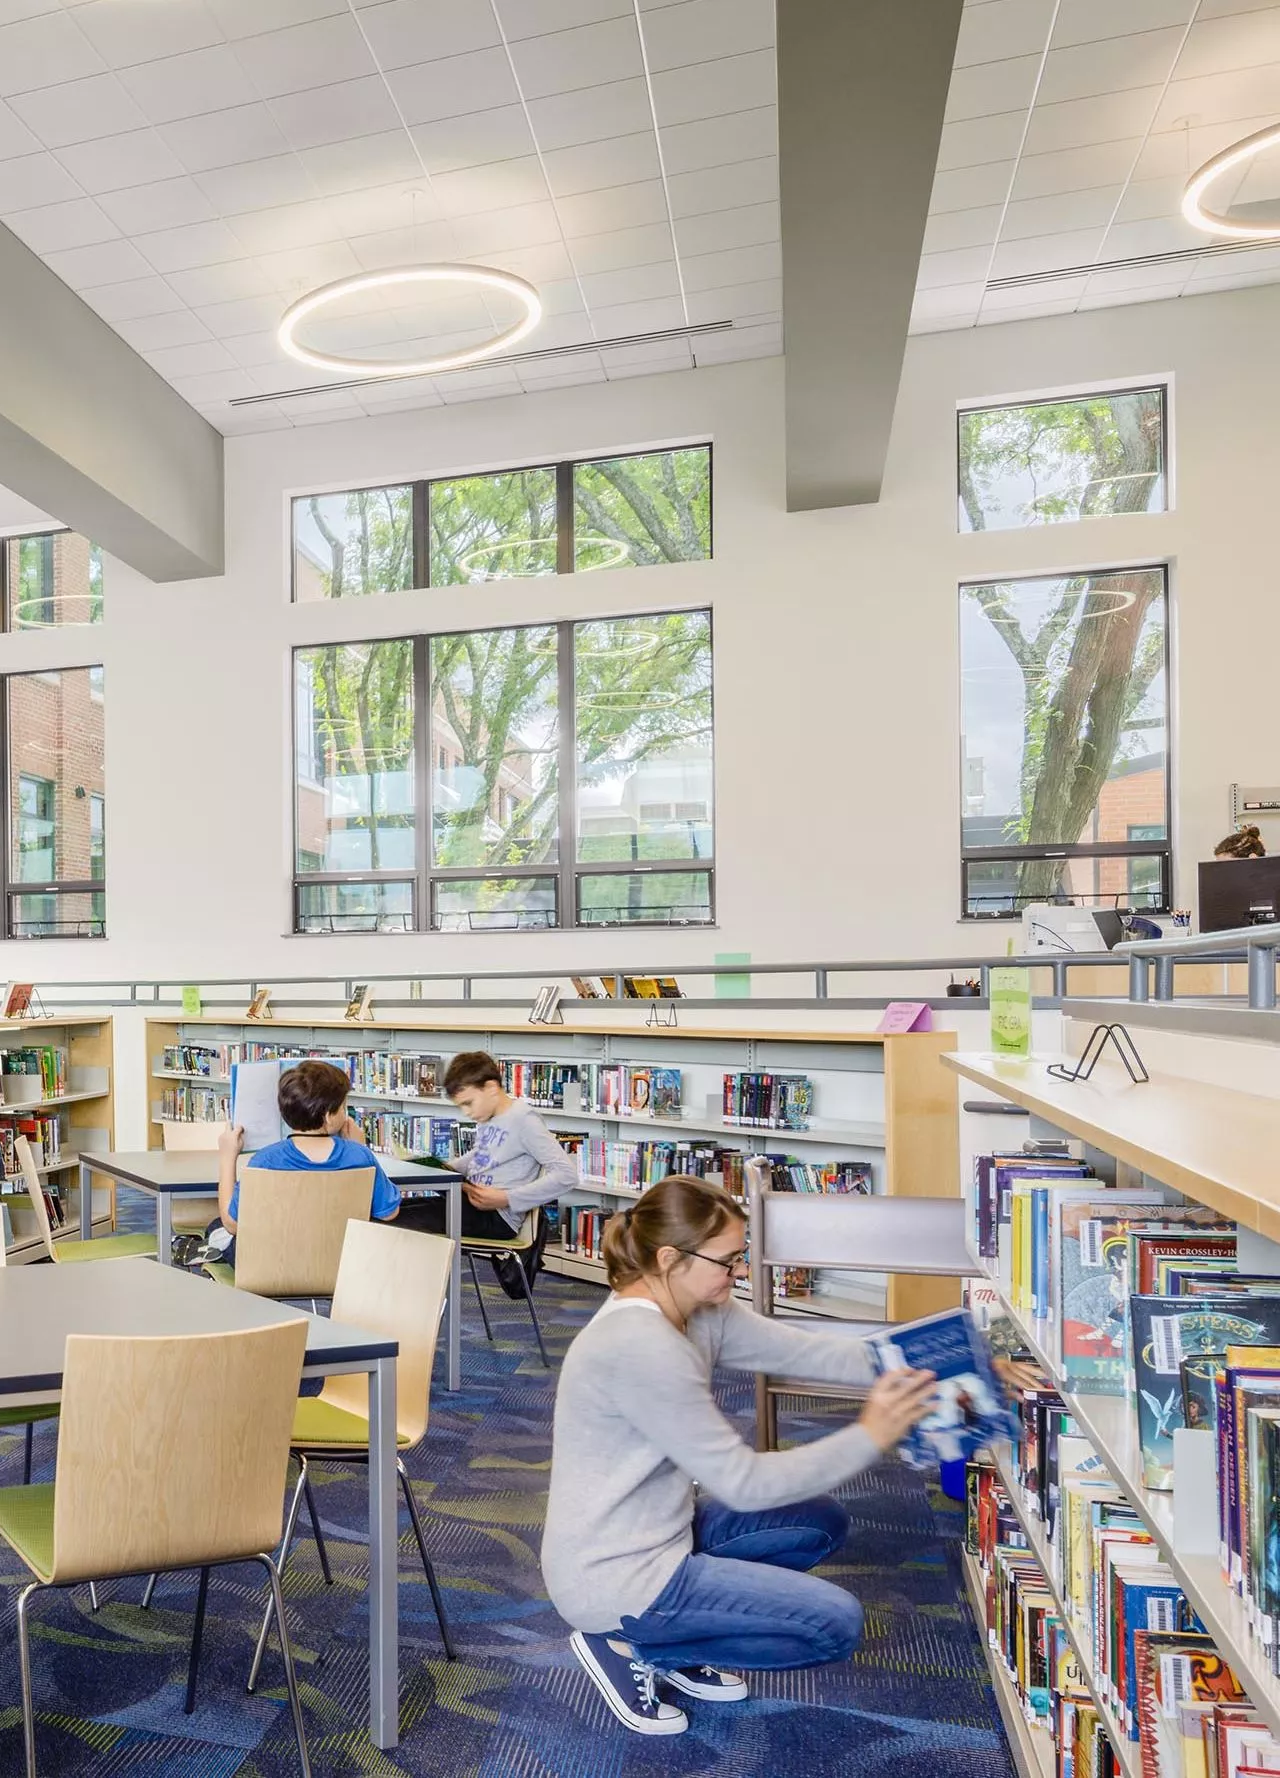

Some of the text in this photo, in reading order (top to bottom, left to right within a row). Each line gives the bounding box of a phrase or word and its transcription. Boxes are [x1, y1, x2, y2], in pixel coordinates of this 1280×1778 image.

[1148, 1247, 1177, 1255] KEVIN
[1225, 1393, 1237, 1507] SARAH DESSEN
